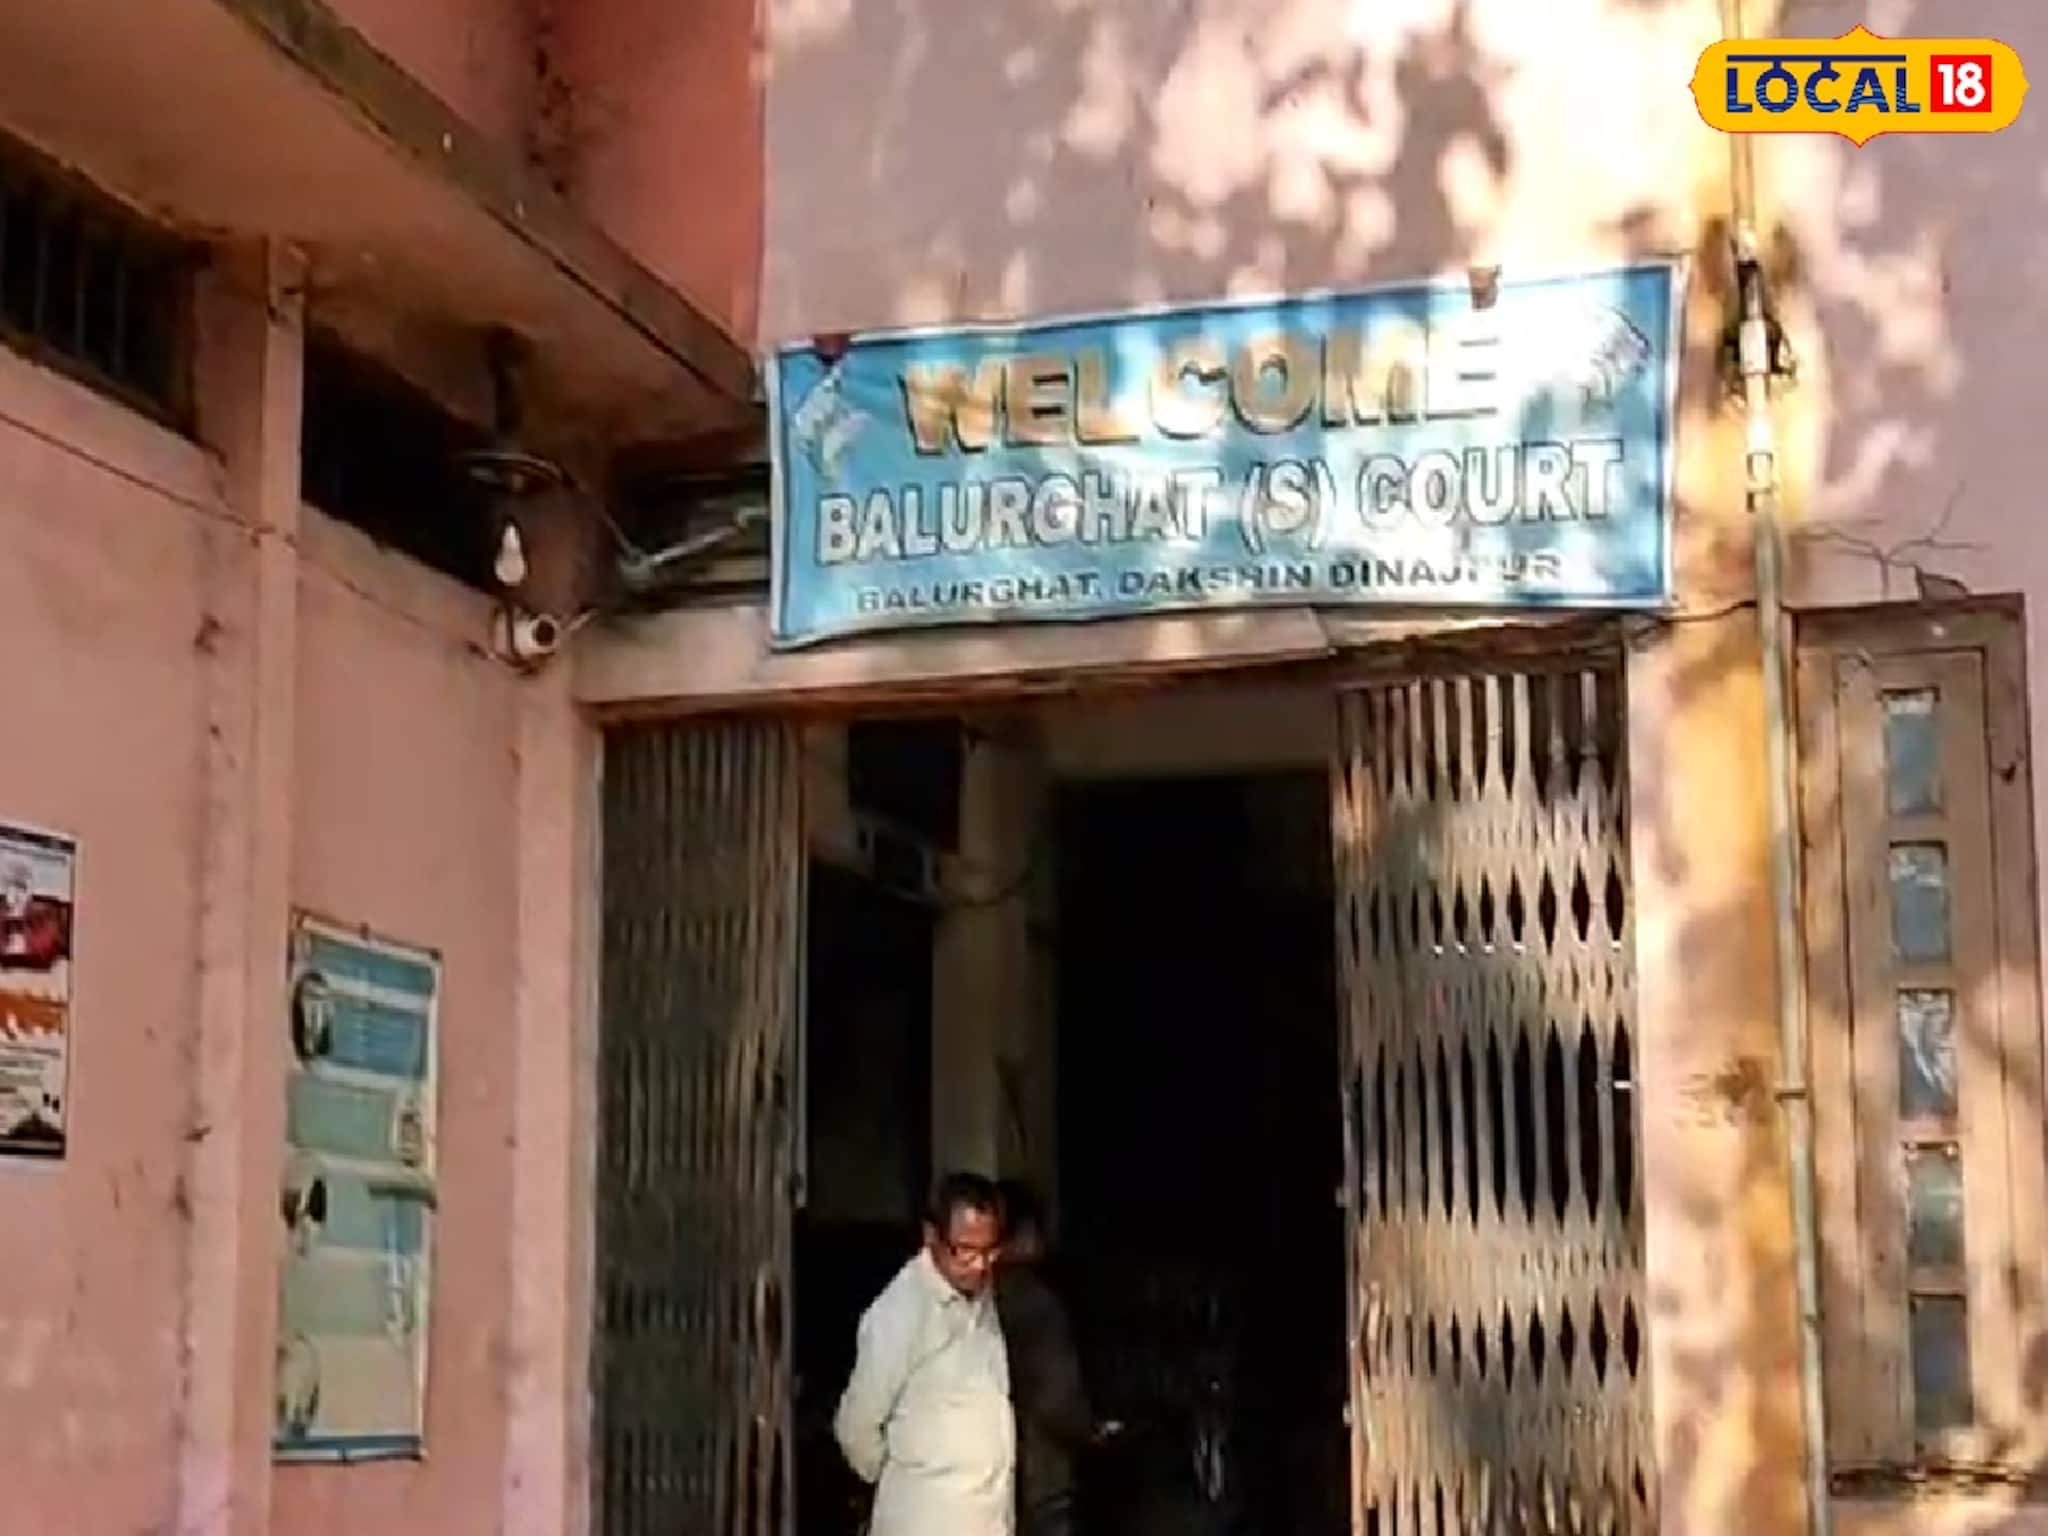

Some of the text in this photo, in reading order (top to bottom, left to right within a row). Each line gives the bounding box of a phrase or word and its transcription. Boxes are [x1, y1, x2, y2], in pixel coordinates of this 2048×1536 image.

[899, 310, 1499, 456] WELCOME
[816, 438, 1624, 567] BALURGHAT (S) COURT
[1119, 563, 1312, 597] DAKSHIN
